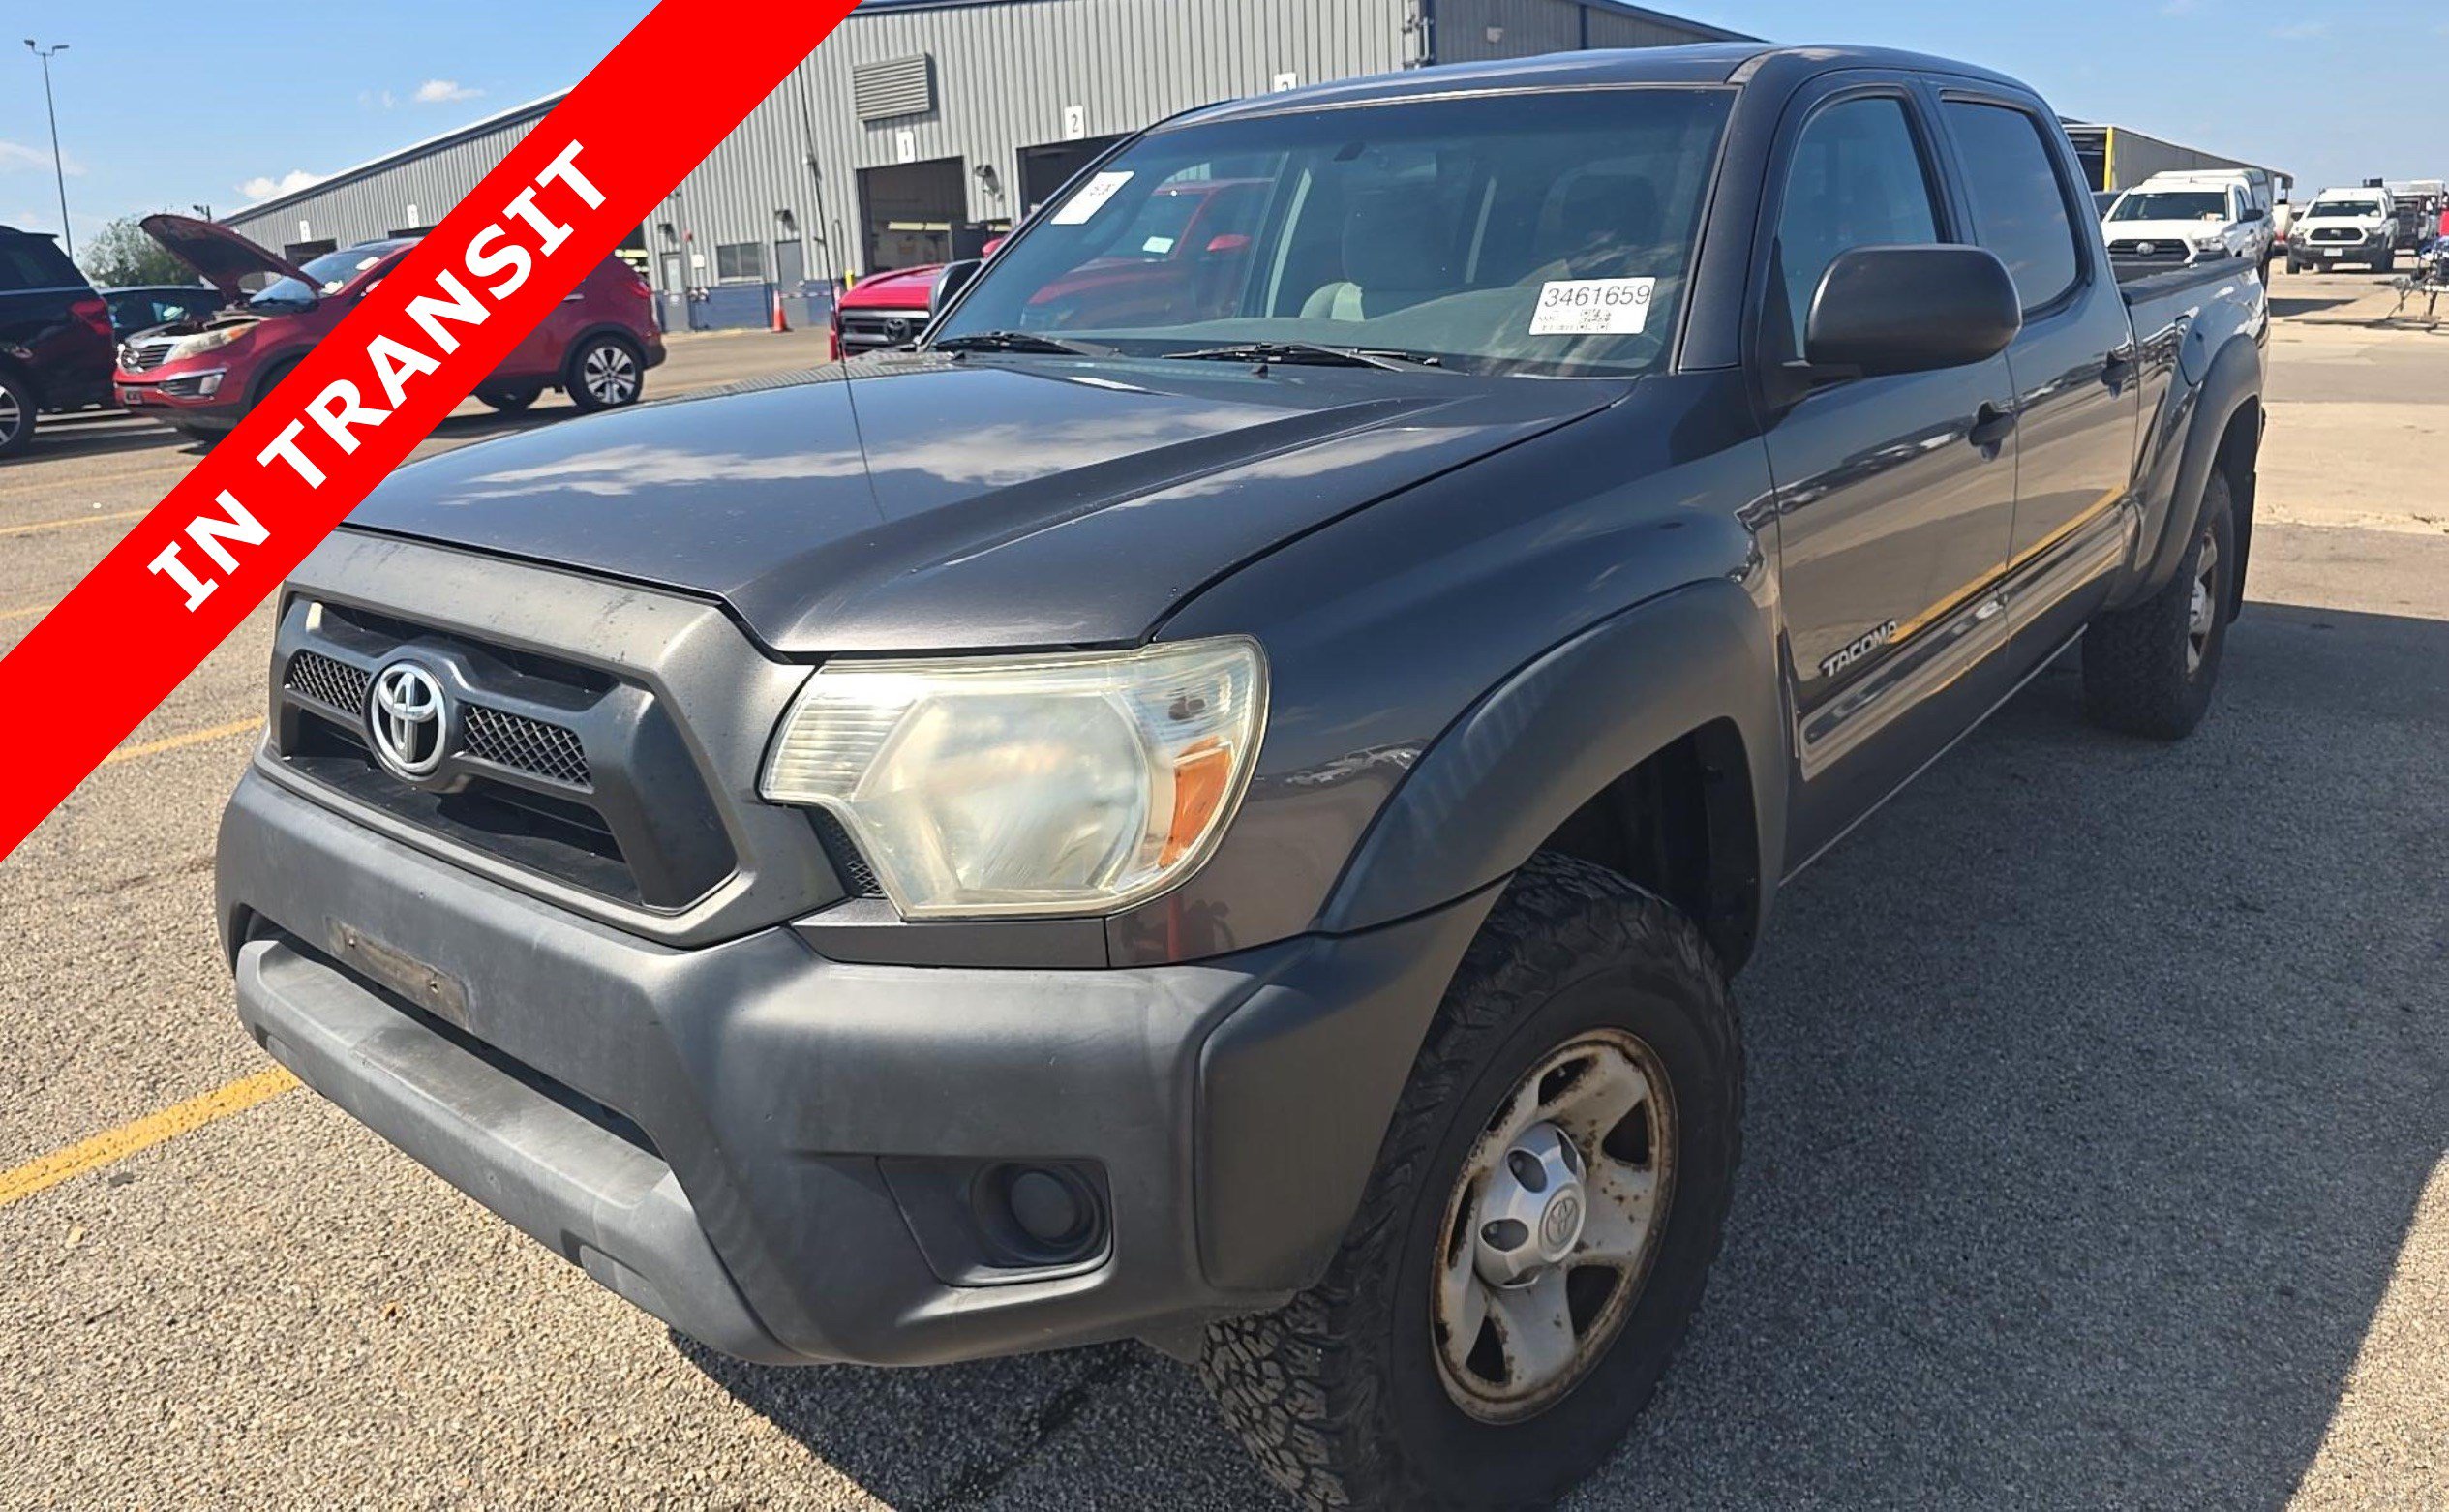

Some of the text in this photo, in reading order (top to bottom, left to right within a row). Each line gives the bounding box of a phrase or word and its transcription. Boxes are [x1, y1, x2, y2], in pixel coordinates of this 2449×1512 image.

[1072, 113, 1079, 133] 2
[1544, 284, 1651, 308] 3461659
[1821, 620, 1897, 678] TACOMA
